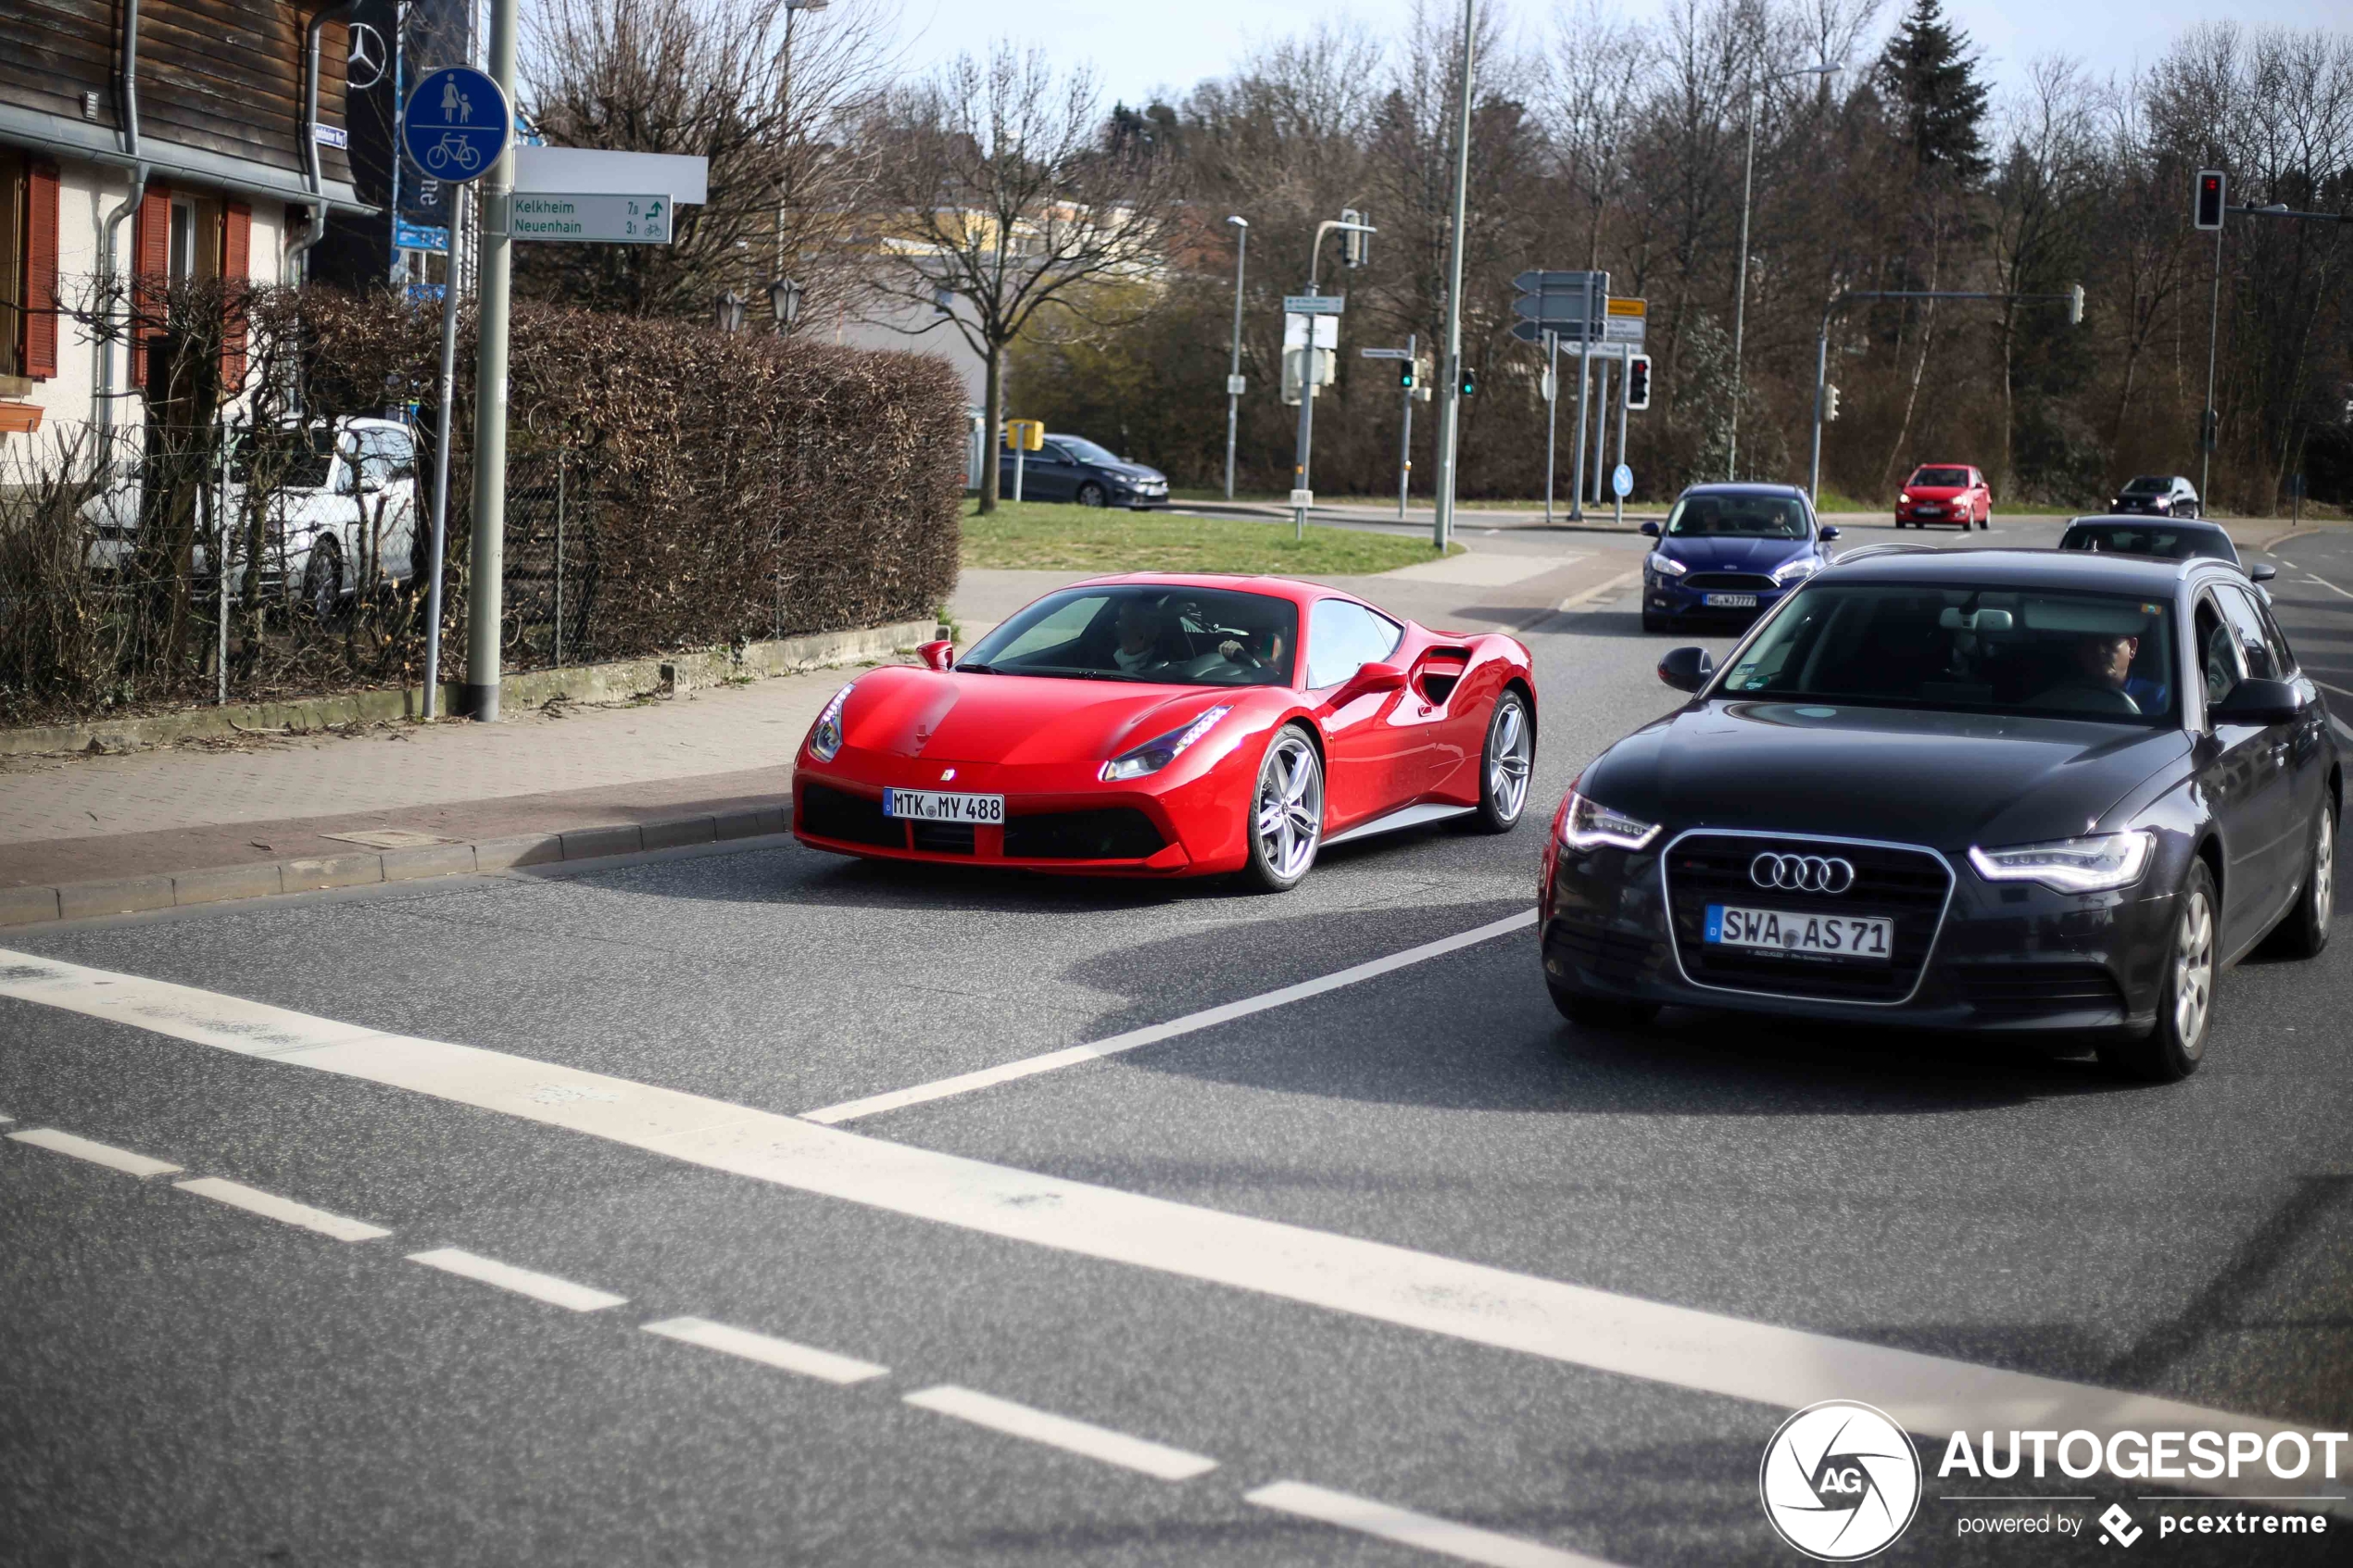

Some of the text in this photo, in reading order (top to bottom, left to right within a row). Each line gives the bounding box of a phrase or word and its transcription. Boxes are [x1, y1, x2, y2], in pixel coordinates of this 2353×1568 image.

[515, 200, 574, 214] Kelkheim
[514, 220, 582, 233] Neuenhain
[893, 793, 925, 816] MTK
[937, 796, 961, 819] MY
[965, 797, 1001, 821] 488
[1723, 910, 1781, 944] SWA
[1803, 918, 1843, 949] AS
[1850, 921, 1886, 954] 71
